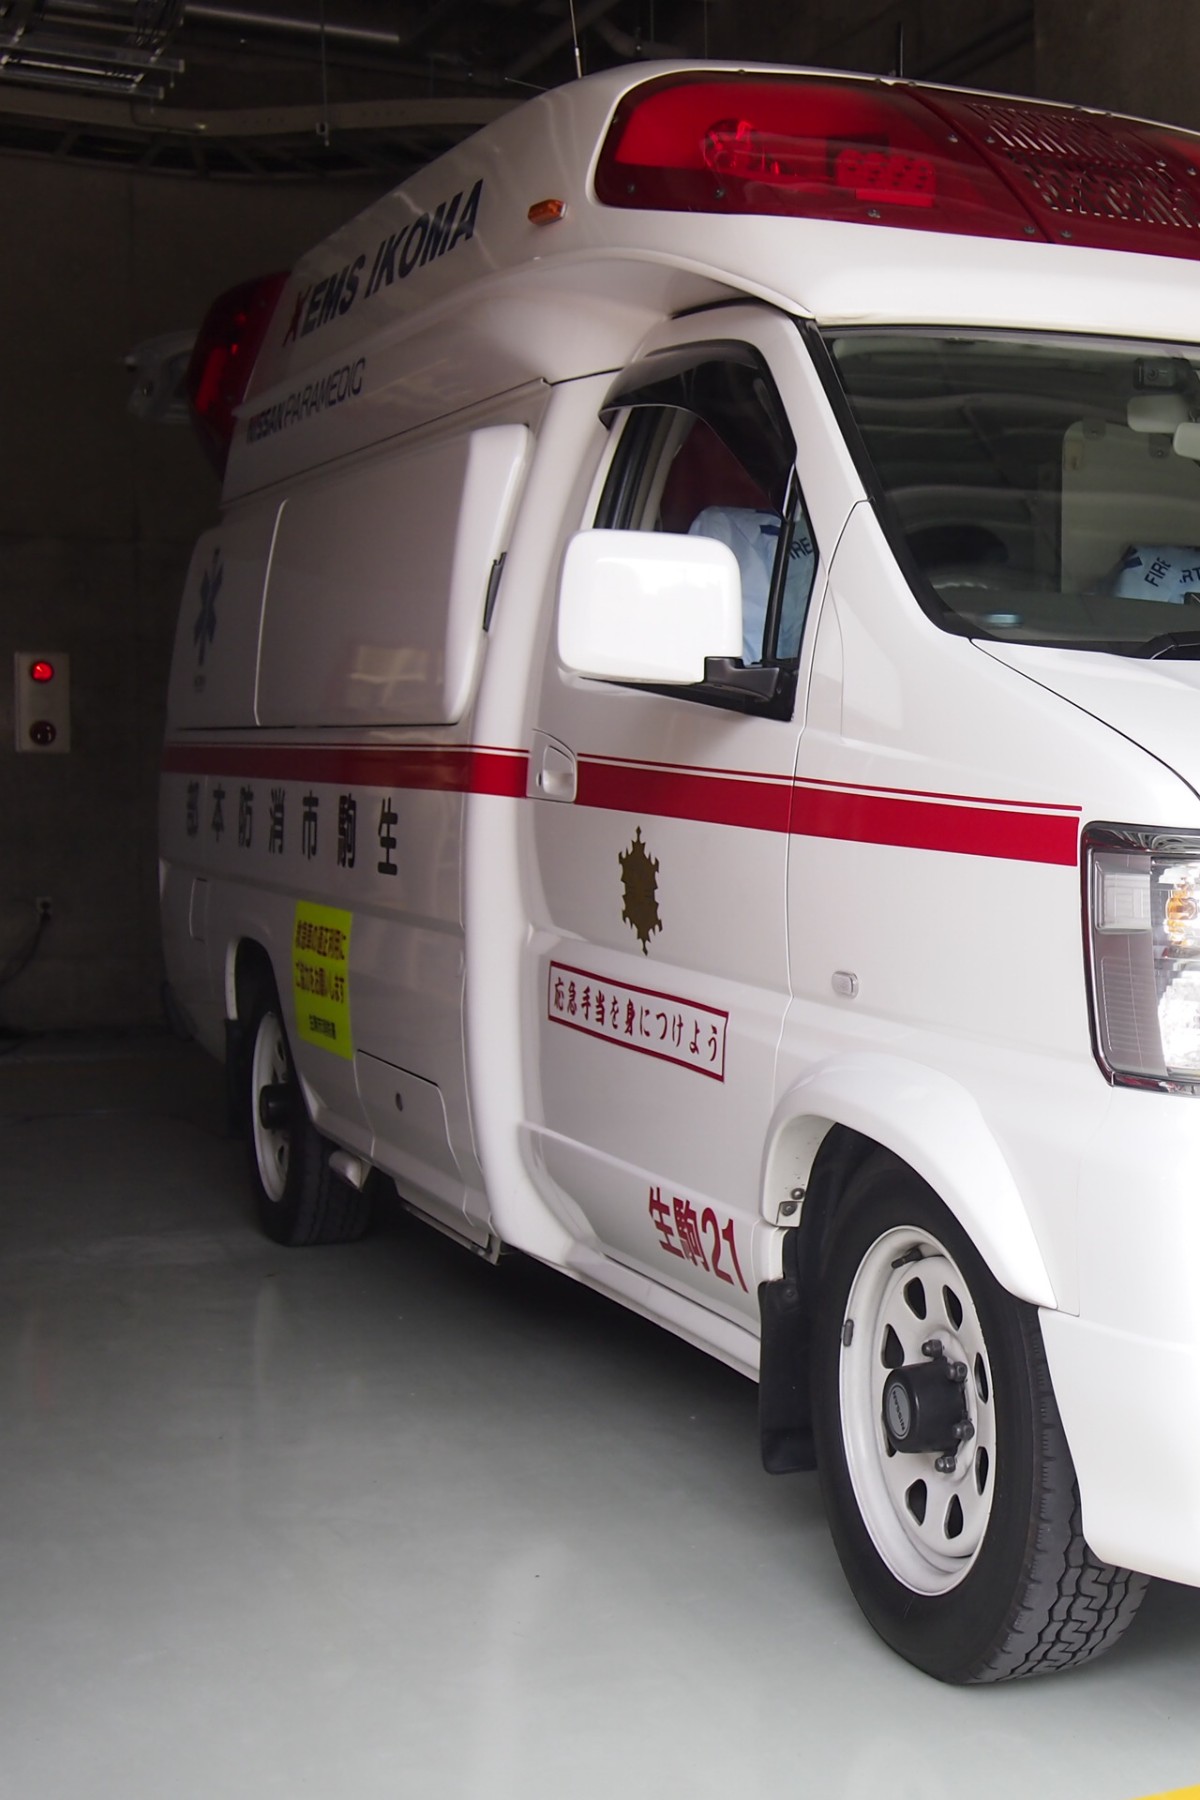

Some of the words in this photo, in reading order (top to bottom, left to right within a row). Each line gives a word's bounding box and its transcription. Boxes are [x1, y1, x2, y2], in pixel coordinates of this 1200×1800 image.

[364, 179, 484, 299] IKOMA
[284, 357, 366, 428] PARAMEDIC
[554, 976, 718, 1062] 応急手当を身につけよう
